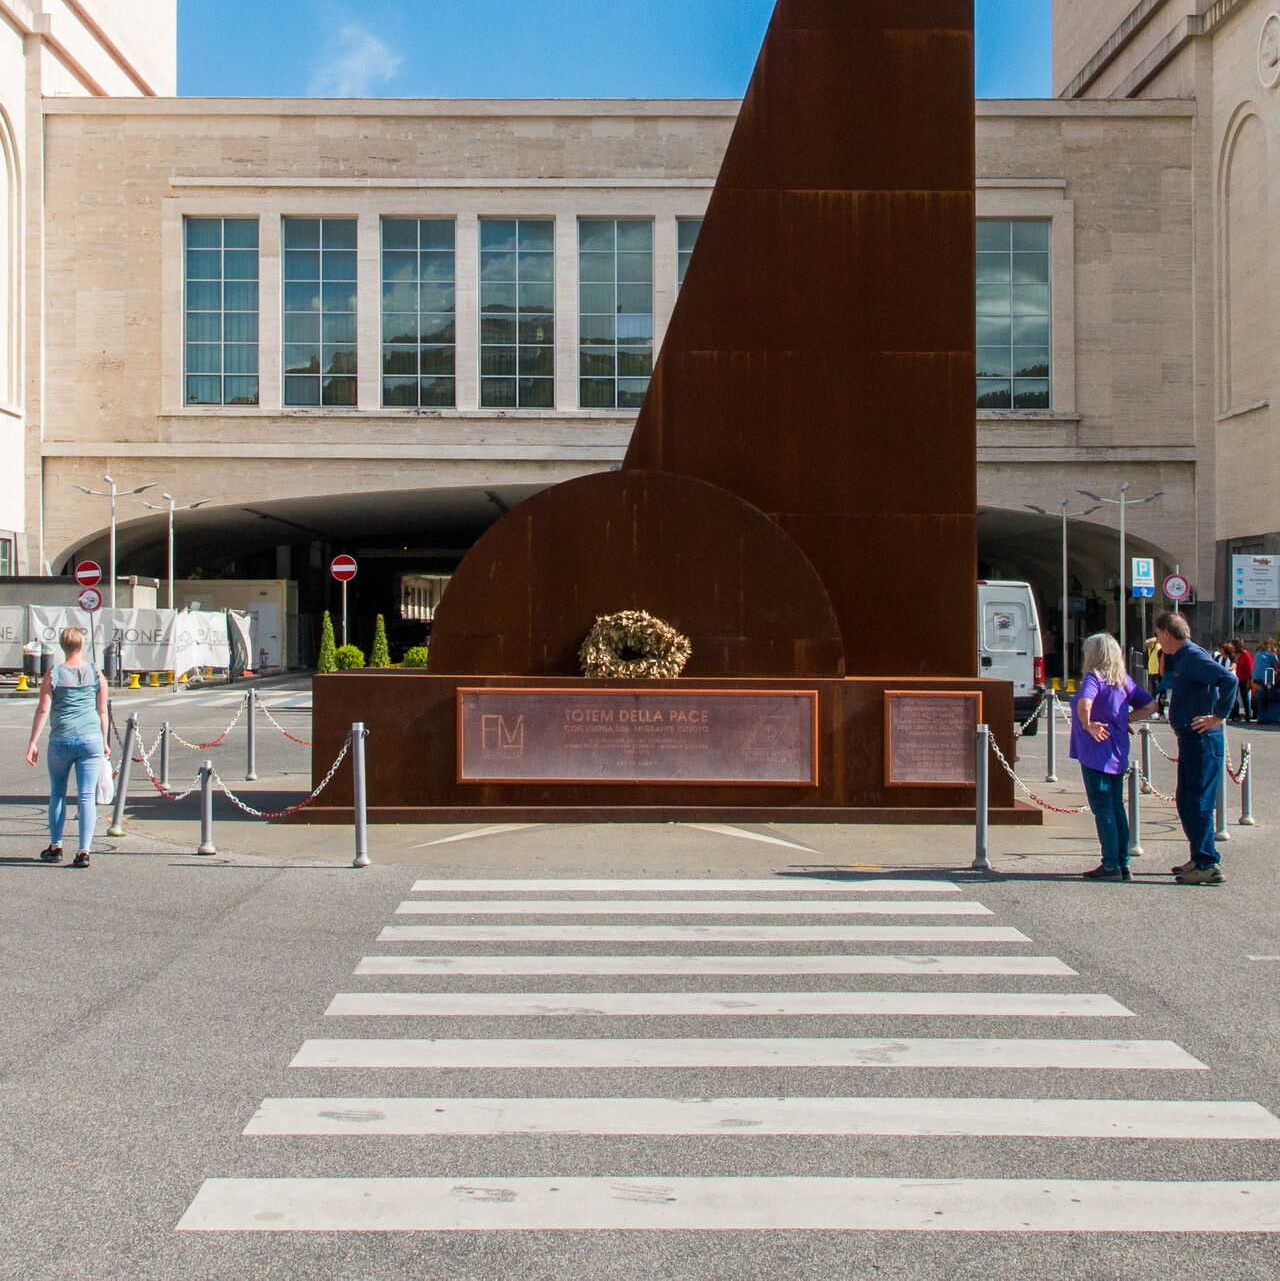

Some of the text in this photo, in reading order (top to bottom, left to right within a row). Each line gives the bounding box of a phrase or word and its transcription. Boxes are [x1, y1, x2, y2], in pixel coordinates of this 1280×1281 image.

[1139, 561, 1148, 576] P
[564, 709, 709, 723] TOTEM DELLA PACE
